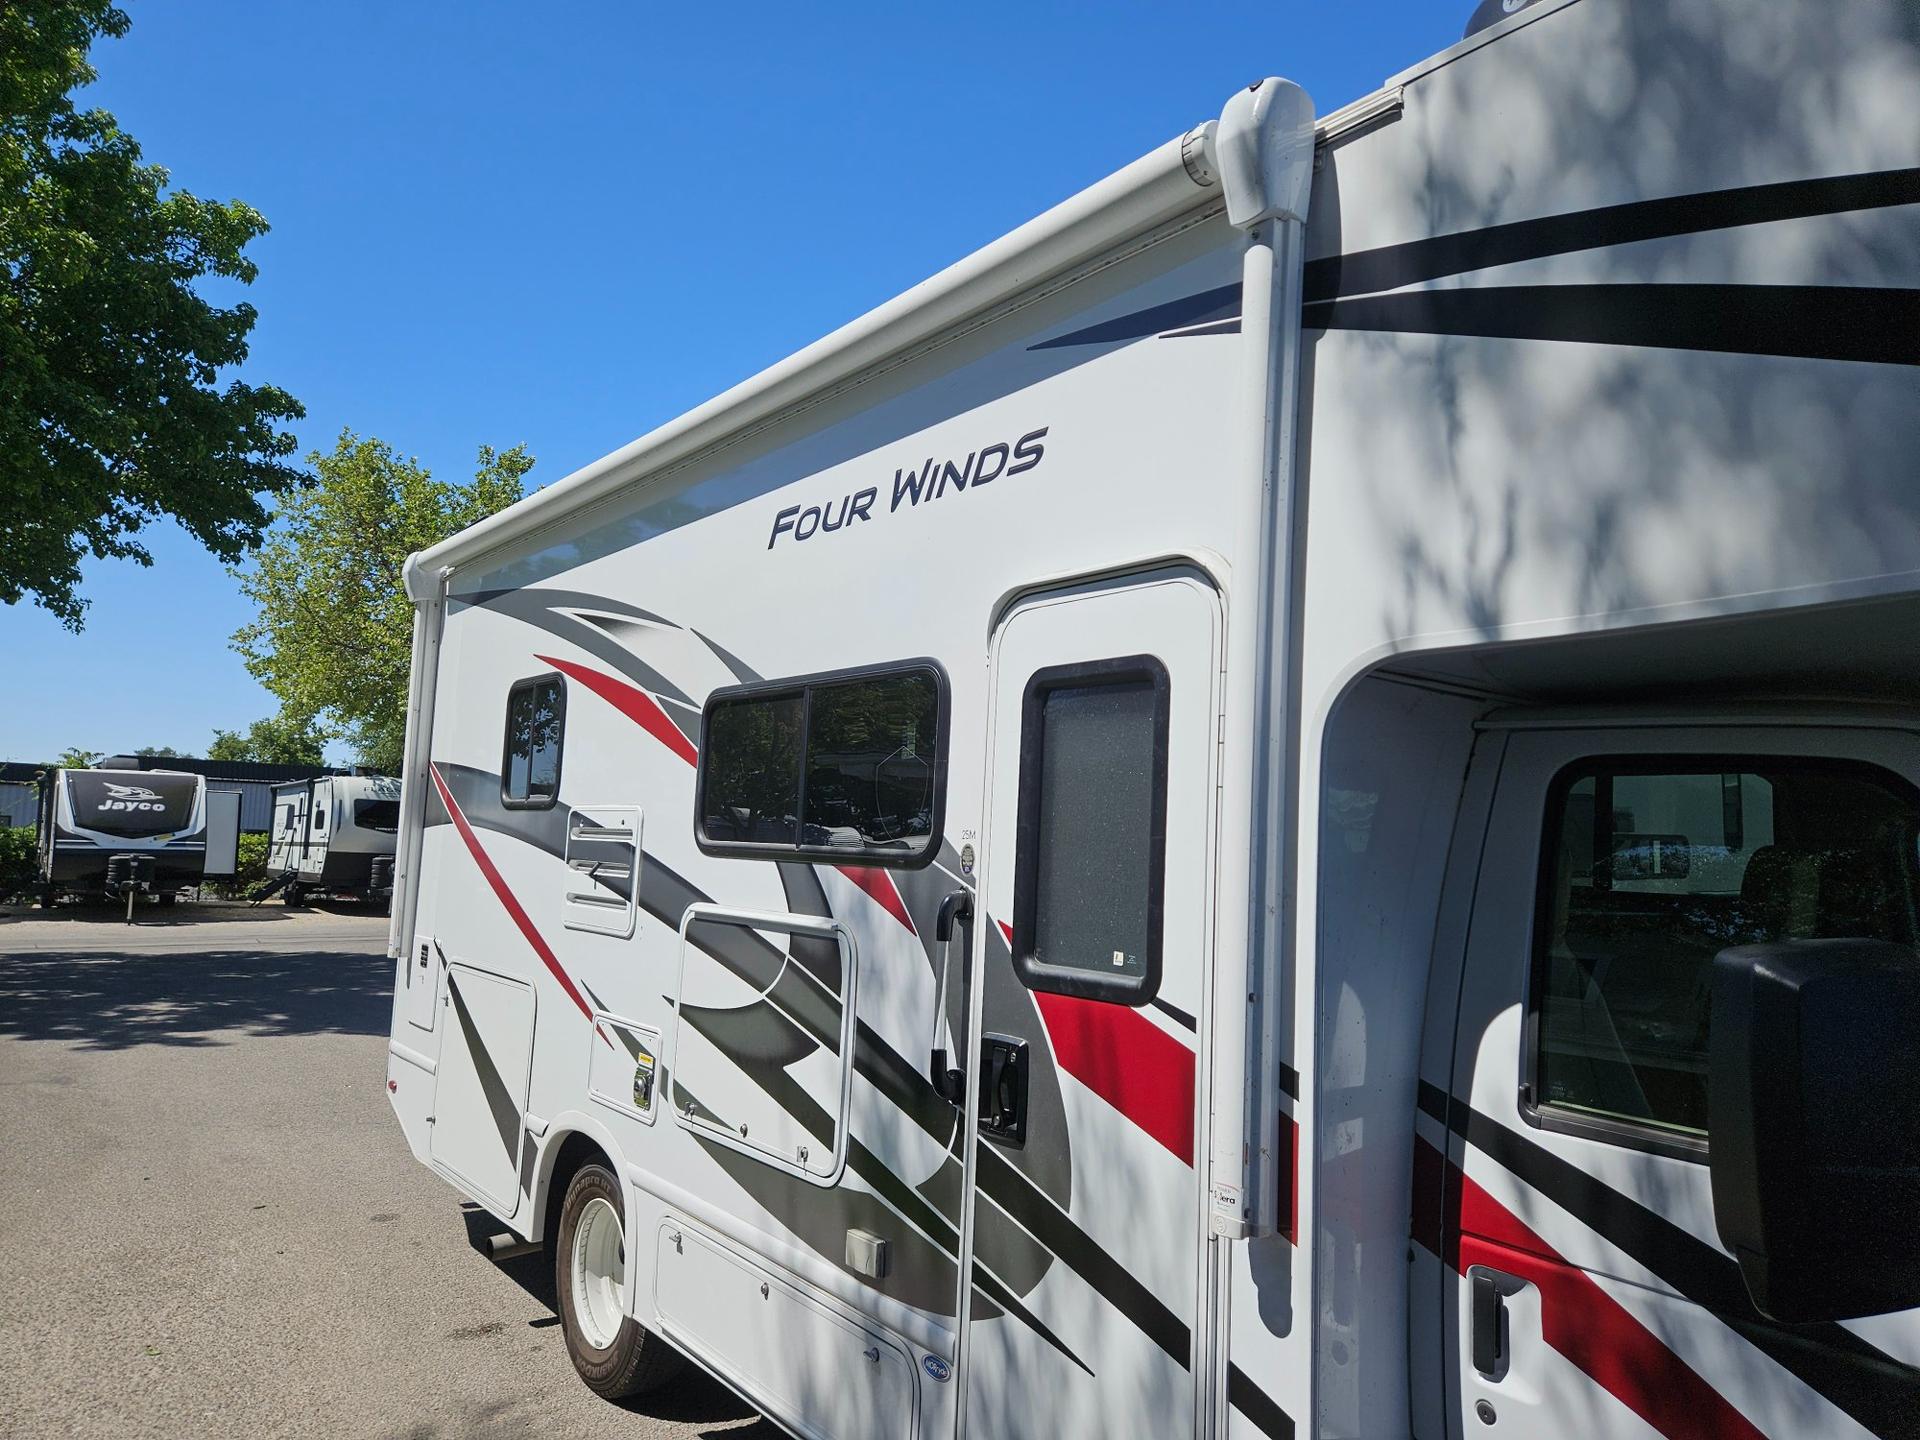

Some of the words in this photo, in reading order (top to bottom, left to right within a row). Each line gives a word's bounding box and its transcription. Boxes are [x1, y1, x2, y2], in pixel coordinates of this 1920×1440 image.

[767, 486, 878, 550] FOUR
[890, 426, 1049, 513] WINDS
[98, 800, 166, 812] Jayco
